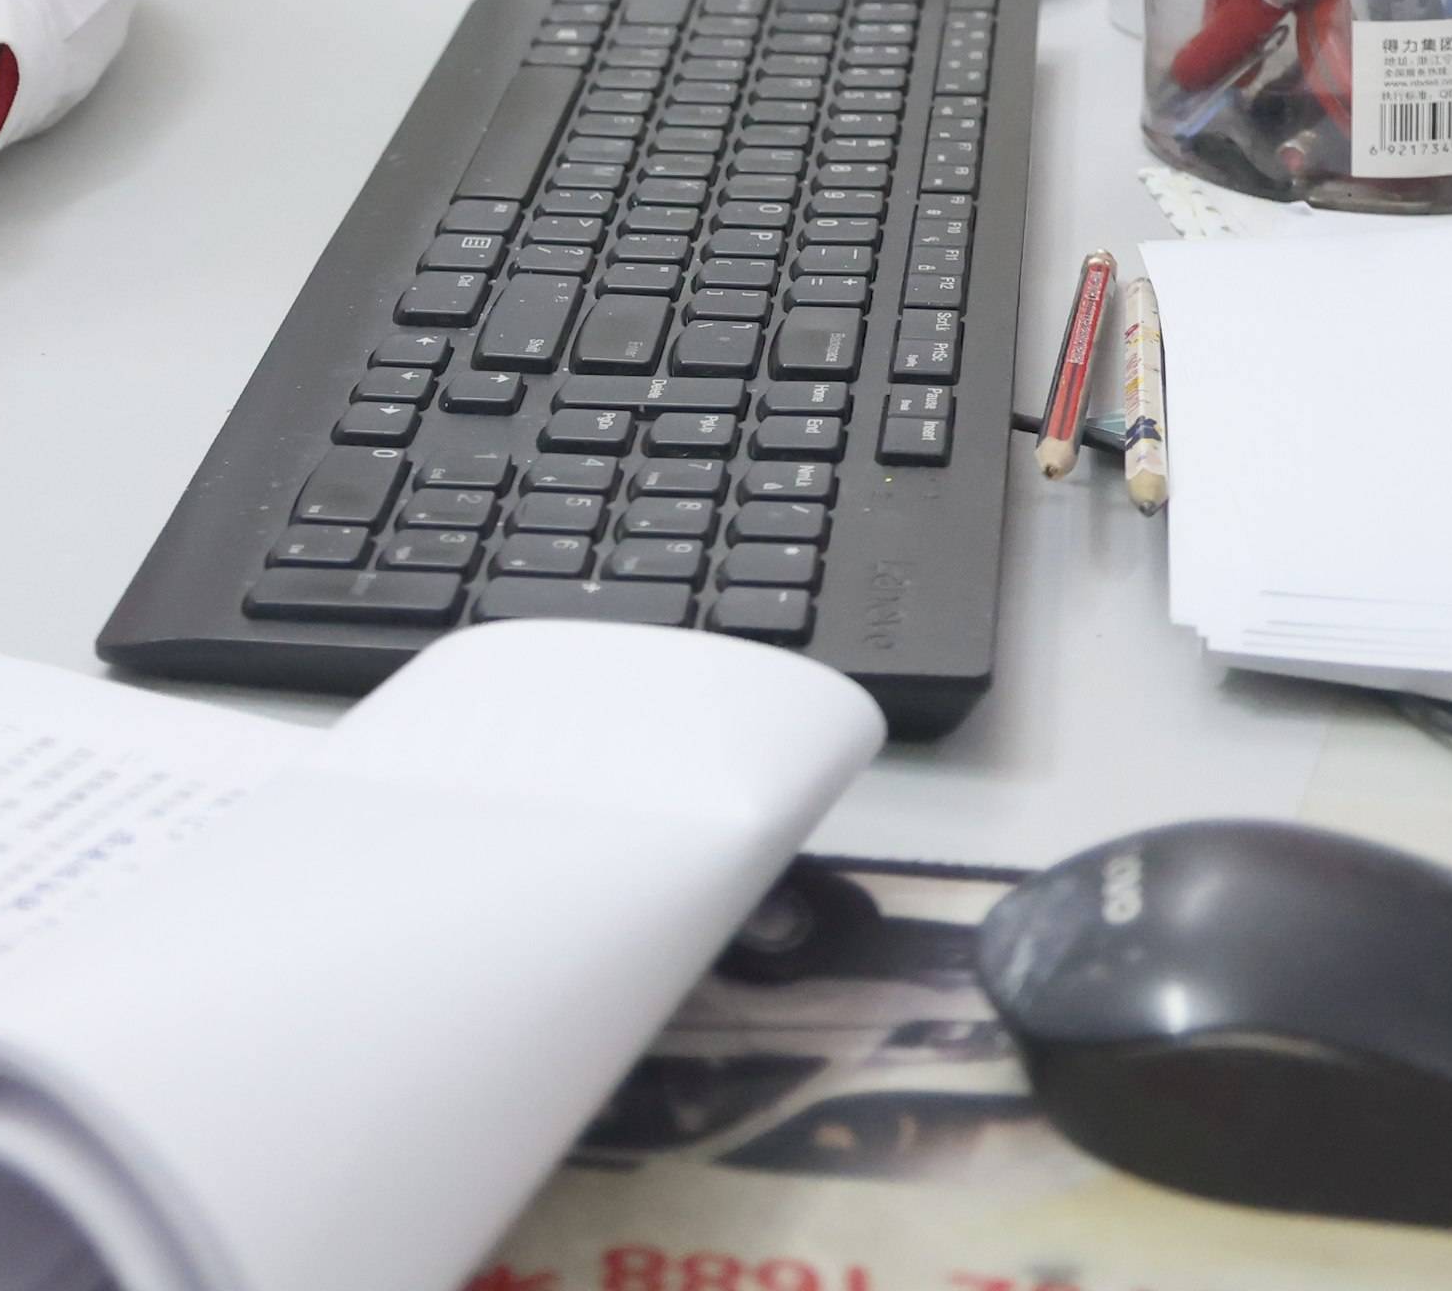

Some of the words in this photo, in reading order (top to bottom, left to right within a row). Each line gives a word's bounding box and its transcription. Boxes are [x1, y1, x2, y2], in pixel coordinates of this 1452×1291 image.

[750, 231, 773, 241] P
[940, 277, 955, 290] F12
[936, 312, 951, 331] ScrLk
[932, 342, 948, 362] PrtSc
[647, 378, 667, 399] Delete
[812, 384, 829, 403] Home
[925, 387, 943, 410] Pause
[596, 411, 616, 431] PgDn
[699, 415, 719, 434] PgUp
[806, 418, 823, 434] End
[921, 421, 939, 440] Insert
[580, 458, 605, 468] 4
[688, 462, 713, 470] 7
[457, 493, 483, 504] 2
[565, 496, 592, 507] 5
[675, 501, 703, 511] 8
[439, 532, 468, 544] 3
[552, 539, 580, 550] 6
[666, 542, 694, 553] 9
